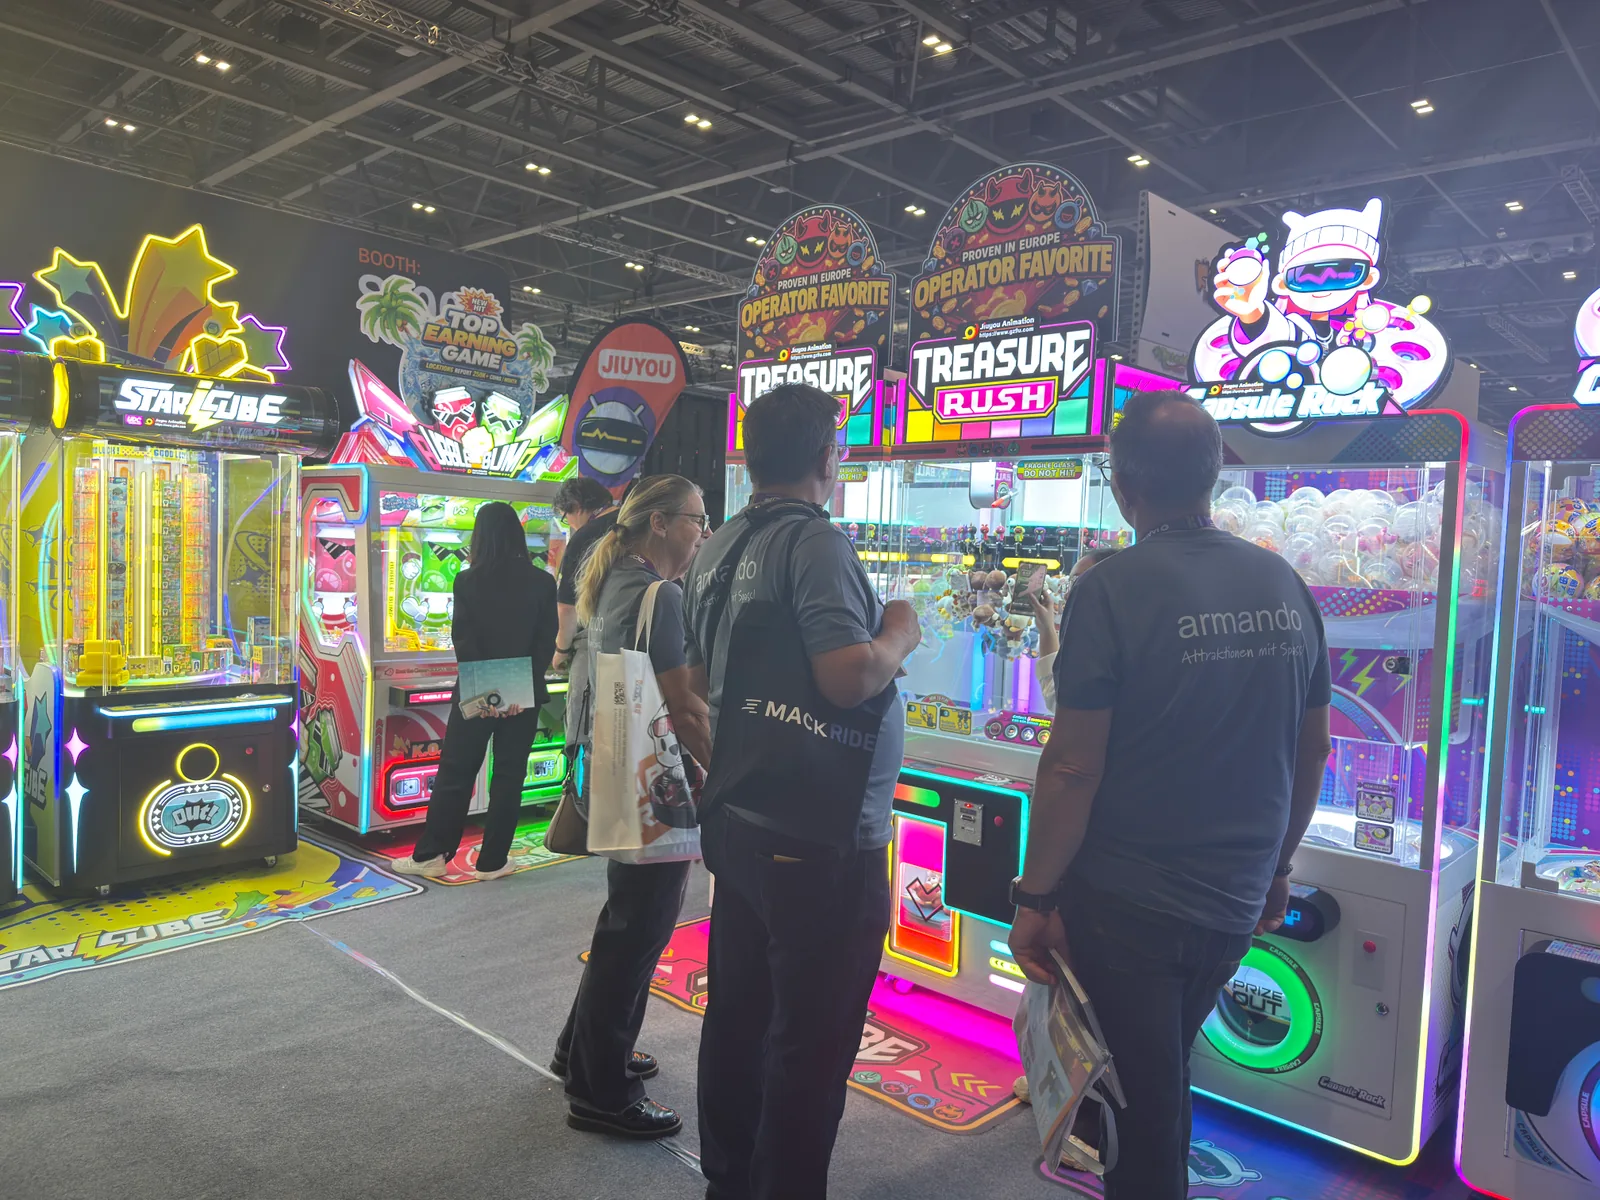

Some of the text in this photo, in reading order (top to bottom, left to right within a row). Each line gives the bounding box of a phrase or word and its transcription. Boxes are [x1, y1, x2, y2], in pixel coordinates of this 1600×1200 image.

[962, 232, 1060, 263] PROVEN IN EUROPE
[358, 248, 421, 275] BOOTH:
[777, 268, 851, 290] PROVEN IN EUROPE
[914, 244, 1113, 308] OPERATOR FAVORITE
[471, 298, 488, 307] NEW
[473, 305, 486, 313] HIT
[741, 281, 890, 329] OPERATOR FAVORITE
[447, 310, 499, 335] TOP
[1002, 317, 1035, 327] Animation
[423, 324, 516, 357] EARNING
[441, 345, 501, 370] GAME
[602, 355, 673, 379] JIUYOU
[913, 328, 1091, 397] TREASURE
[943, 385, 1046, 416] RUSH
[1024, 462, 1052, 470] FRAGILE
[1024, 469, 1076, 478] DO NOT HIT
[453, 506, 468, 516] VS
[1177, 602, 1302, 639] armando
[1181, 647, 1254, 665] Attraktionen
[1258, 643, 1278, 657] mit
[764, 700, 828, 738] MACK
[1269, 946, 1299, 971] CAPSULE
[1232, 979, 1283, 1002] PRIZE
[1232, 991, 1283, 1017] OUT
[1313, 1002, 1321, 1035] CAPSULE
[1580, 1091, 1591, 1129] CAPSULE
